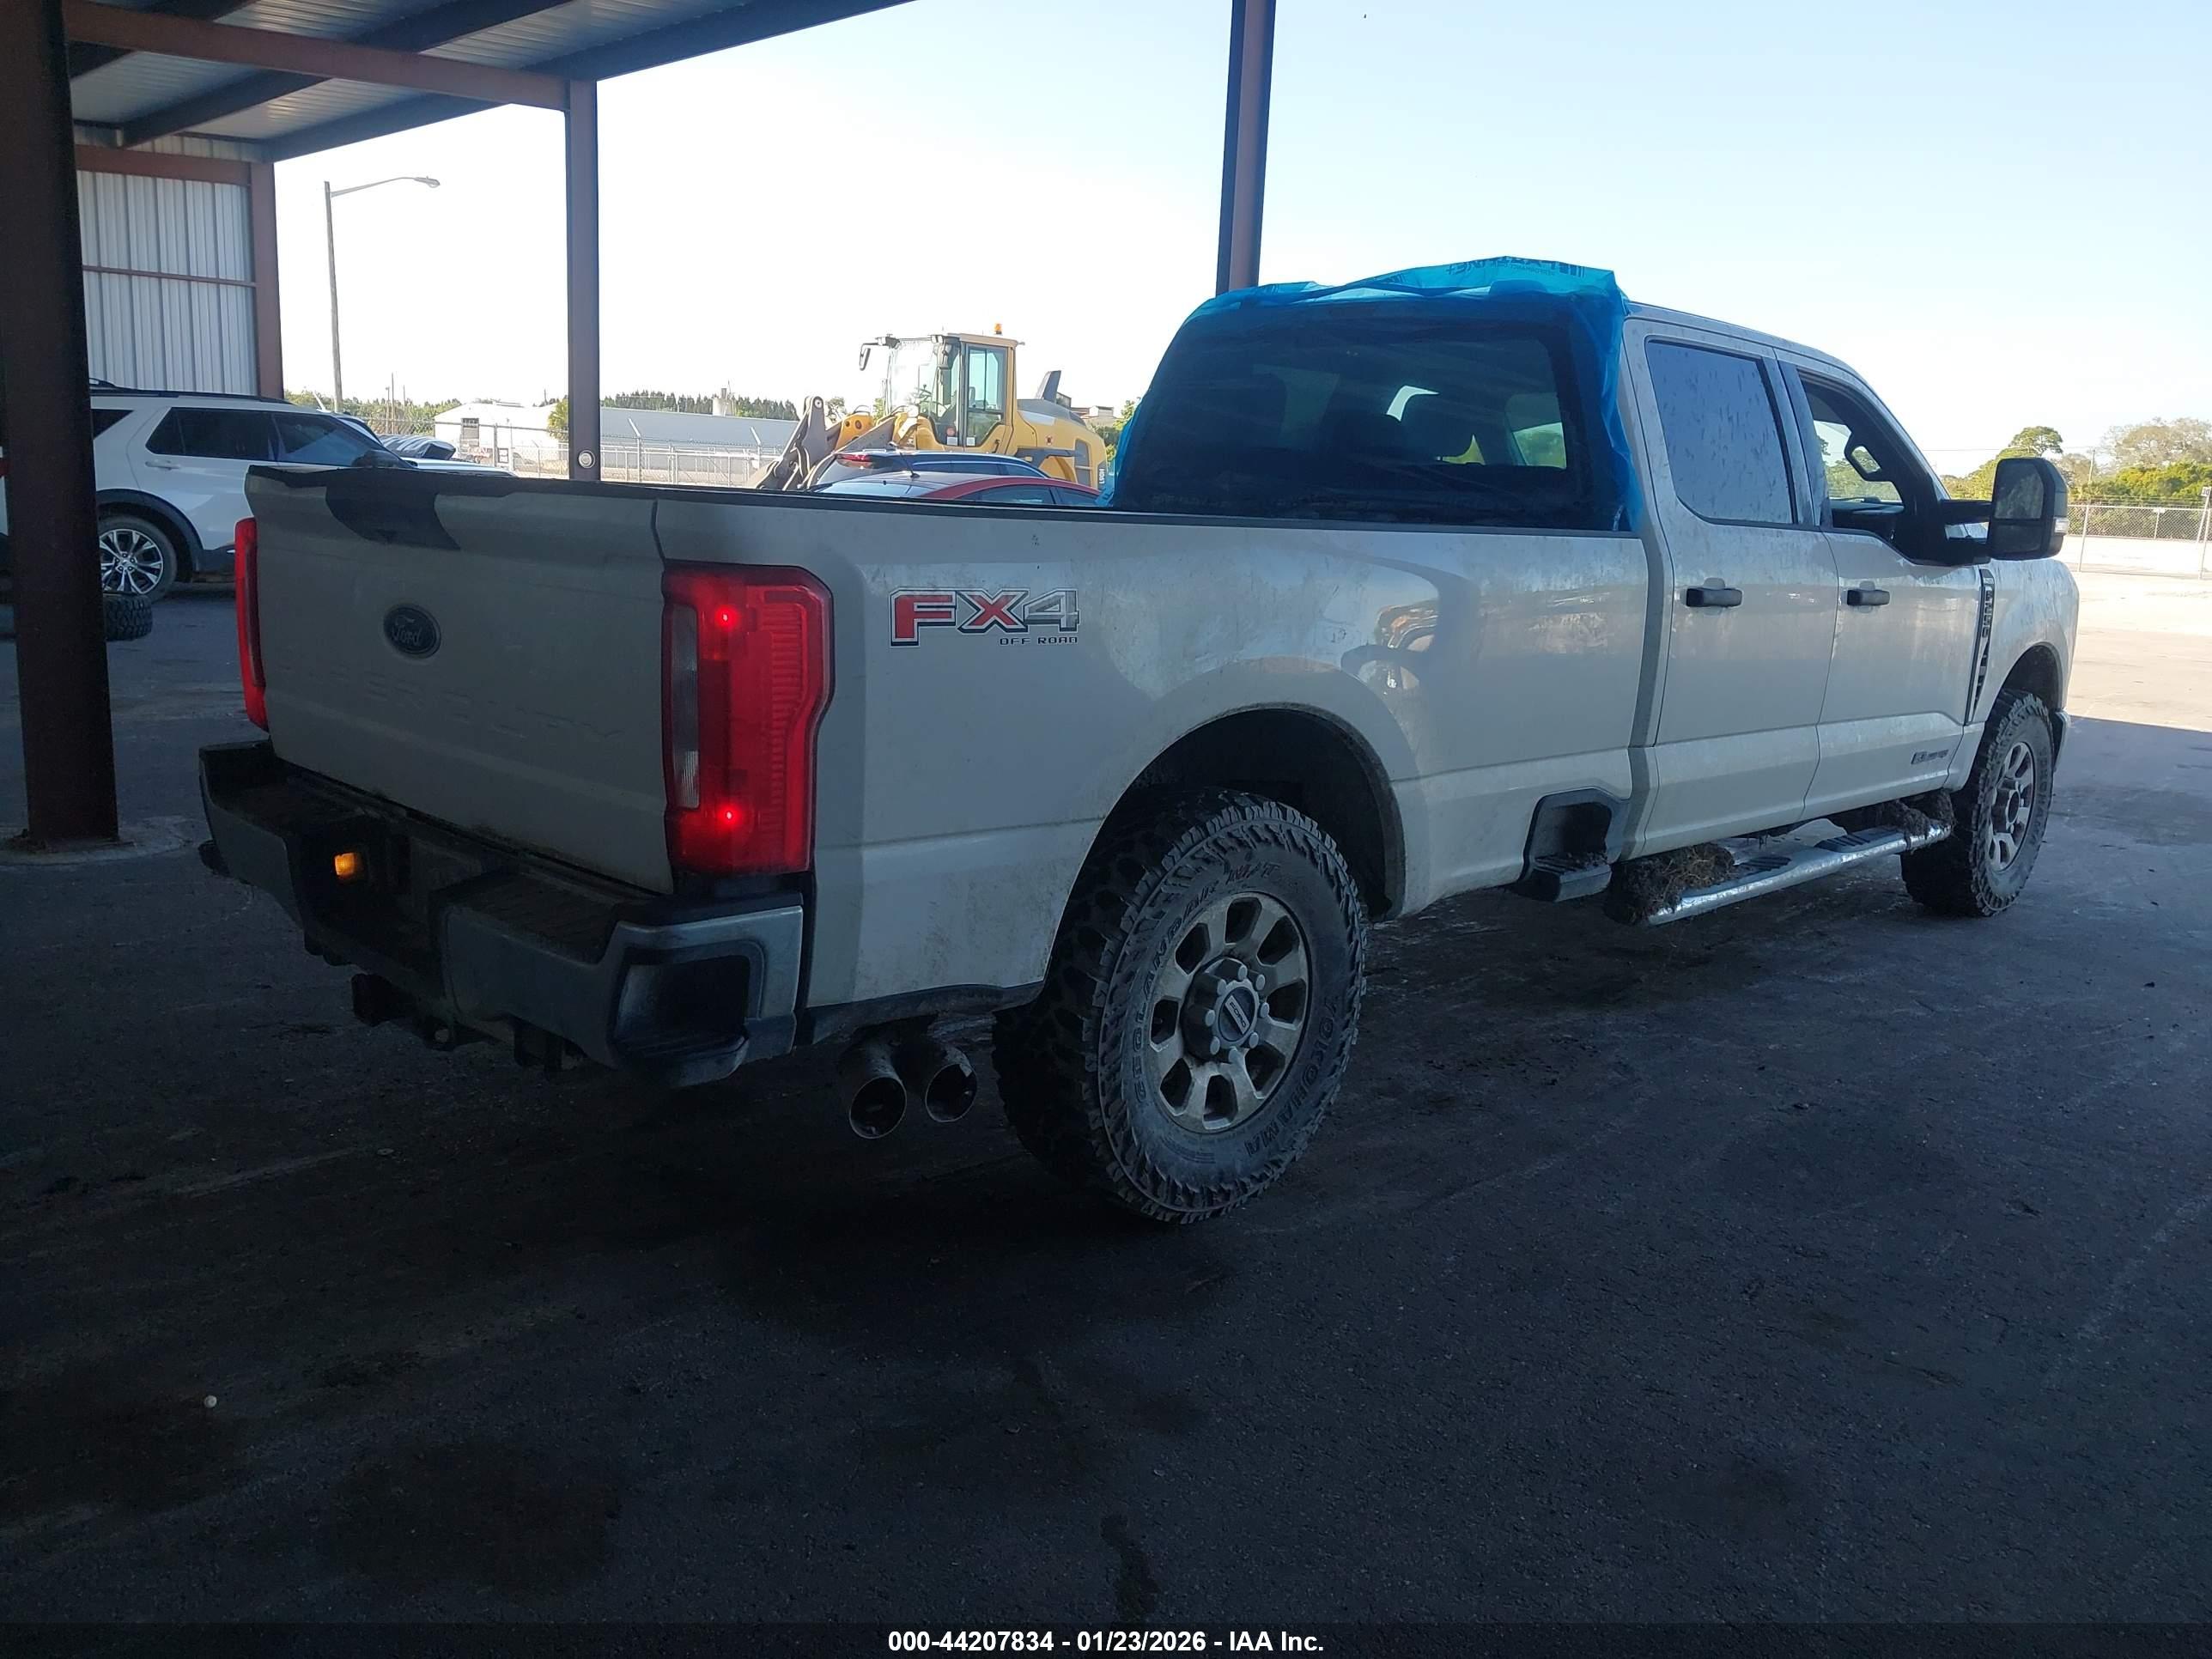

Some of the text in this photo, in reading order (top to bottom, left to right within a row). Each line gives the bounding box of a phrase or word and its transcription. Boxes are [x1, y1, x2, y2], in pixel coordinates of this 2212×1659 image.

[890, 588, 1079, 647] FX4
[1000, 636, 1078, 646] OFF ROAD
[1229, 1001, 1247, 1028] FORD
[1244, 996, 1337, 1157] YOKOHAMA
